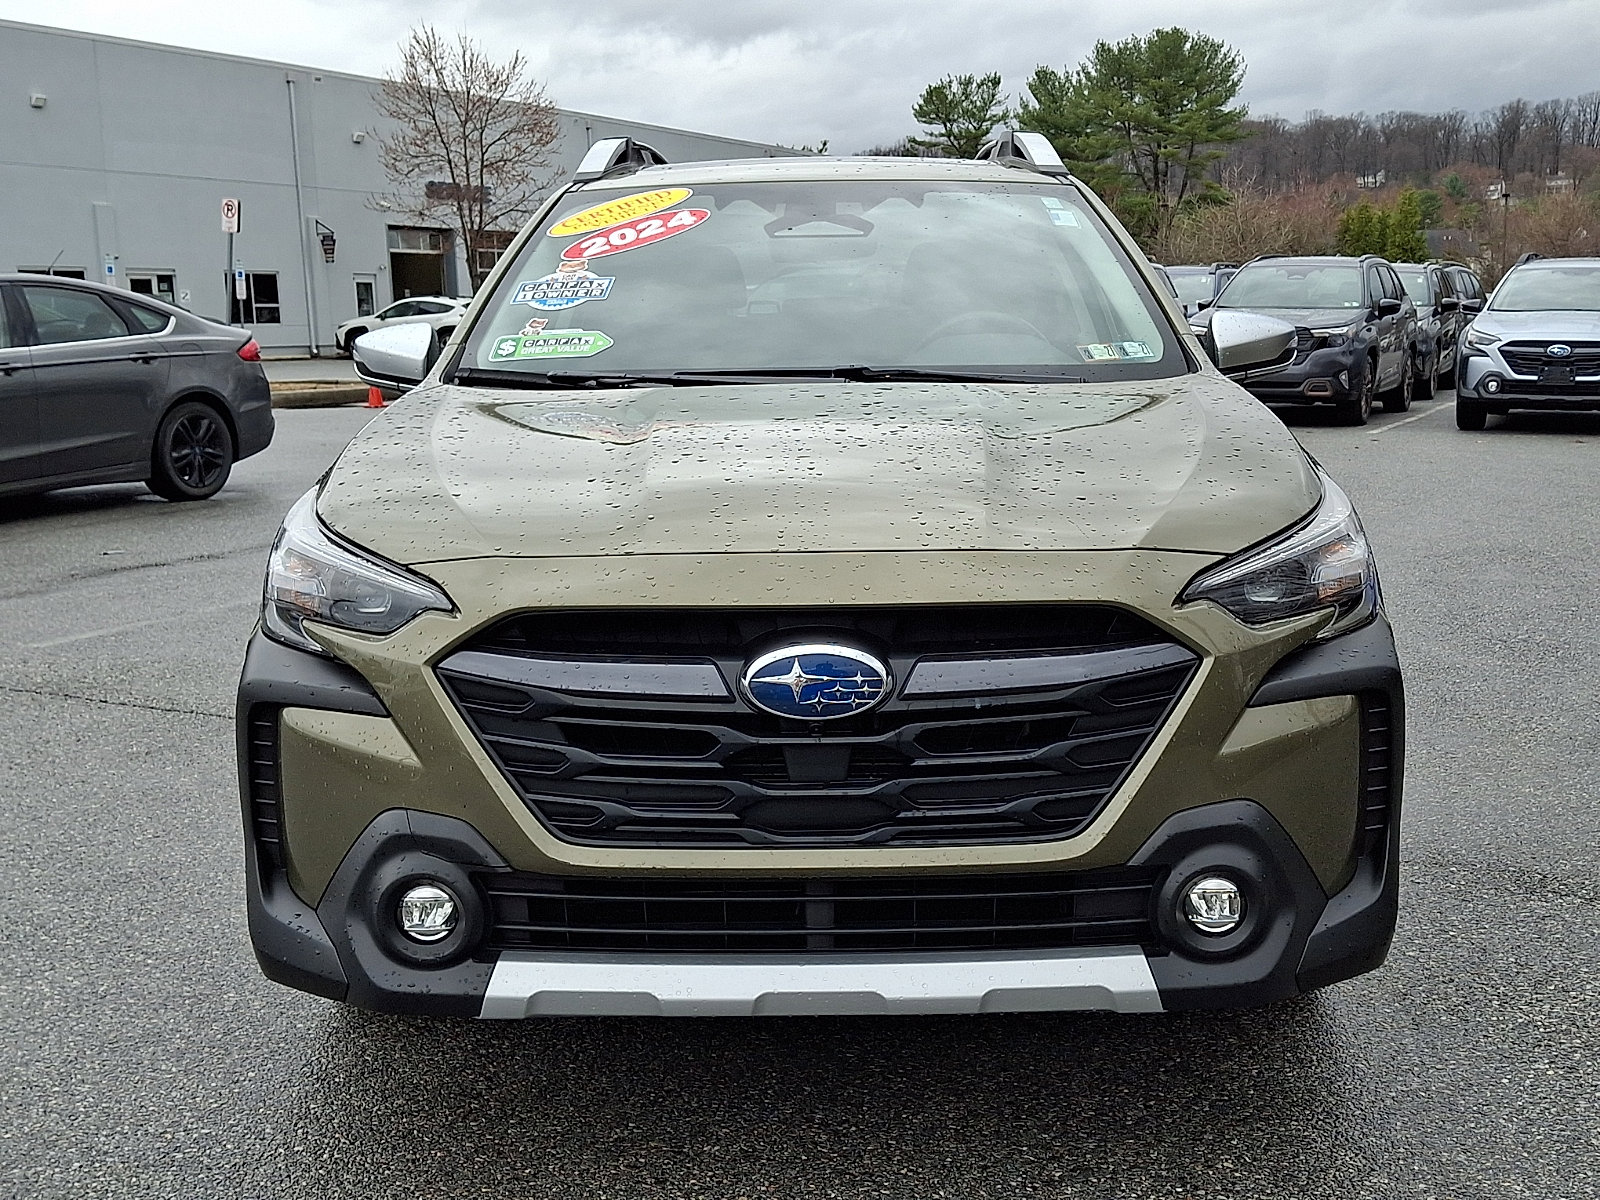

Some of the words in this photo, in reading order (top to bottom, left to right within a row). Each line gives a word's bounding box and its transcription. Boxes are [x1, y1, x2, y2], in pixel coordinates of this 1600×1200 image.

[562, 190, 672, 228] CERTIFIED
[580, 210, 698, 257] 2024
[522, 280, 606, 292] CARFAX
[532, 289, 604, 299] OWNER
[523, 336, 595, 348] CARFAX
[521, 346, 555, 354] GREAT
[557, 344, 591, 353] VALUE
